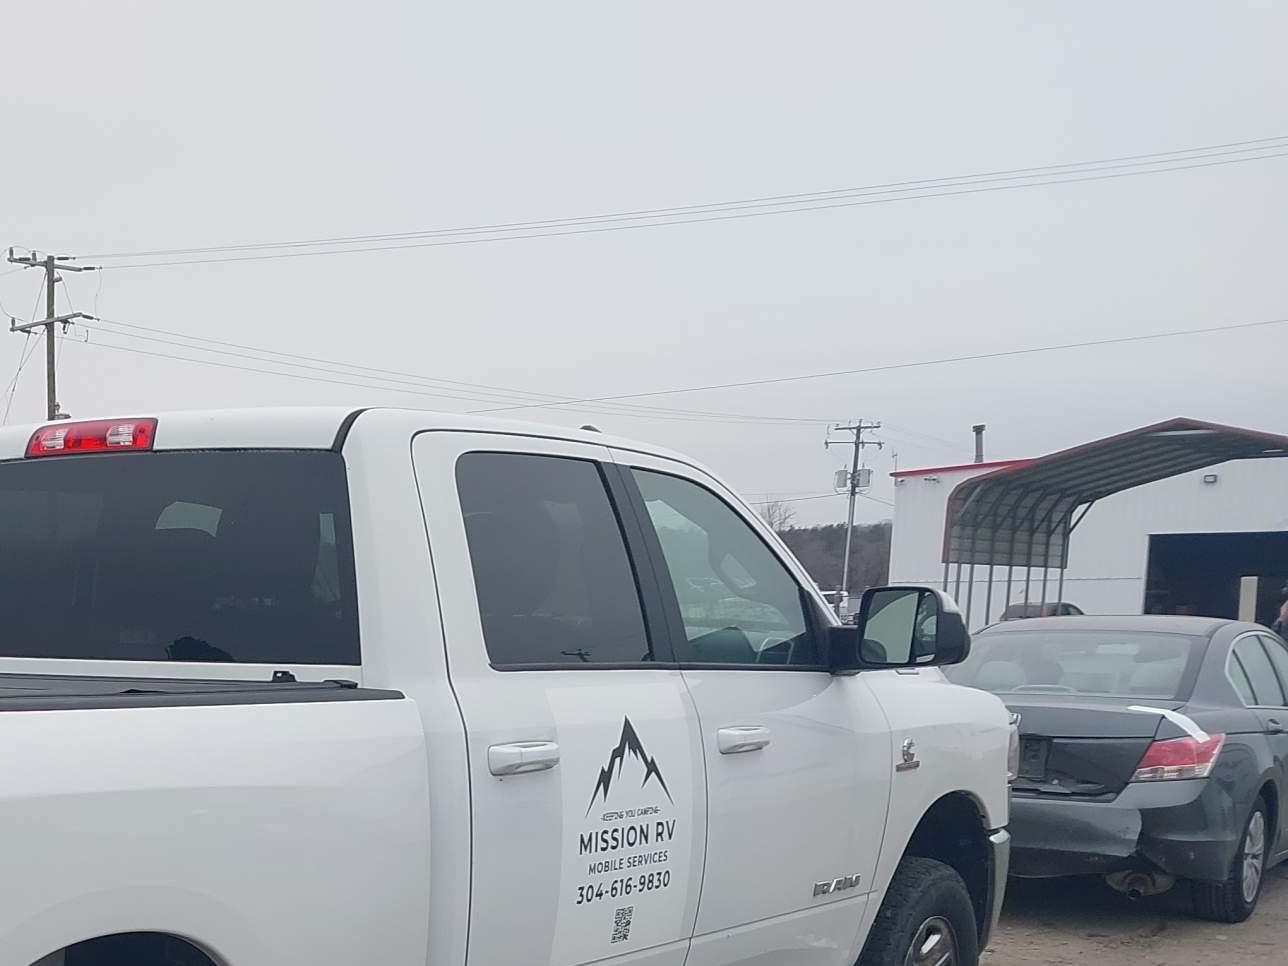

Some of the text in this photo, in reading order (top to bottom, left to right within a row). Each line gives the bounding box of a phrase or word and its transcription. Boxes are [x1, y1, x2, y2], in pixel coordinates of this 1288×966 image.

[579, 819, 676, 855] MISSION RV
[588, 850, 668, 875] MOBILE SERVICES
[576, 870, 671, 905] 304-616-9830
